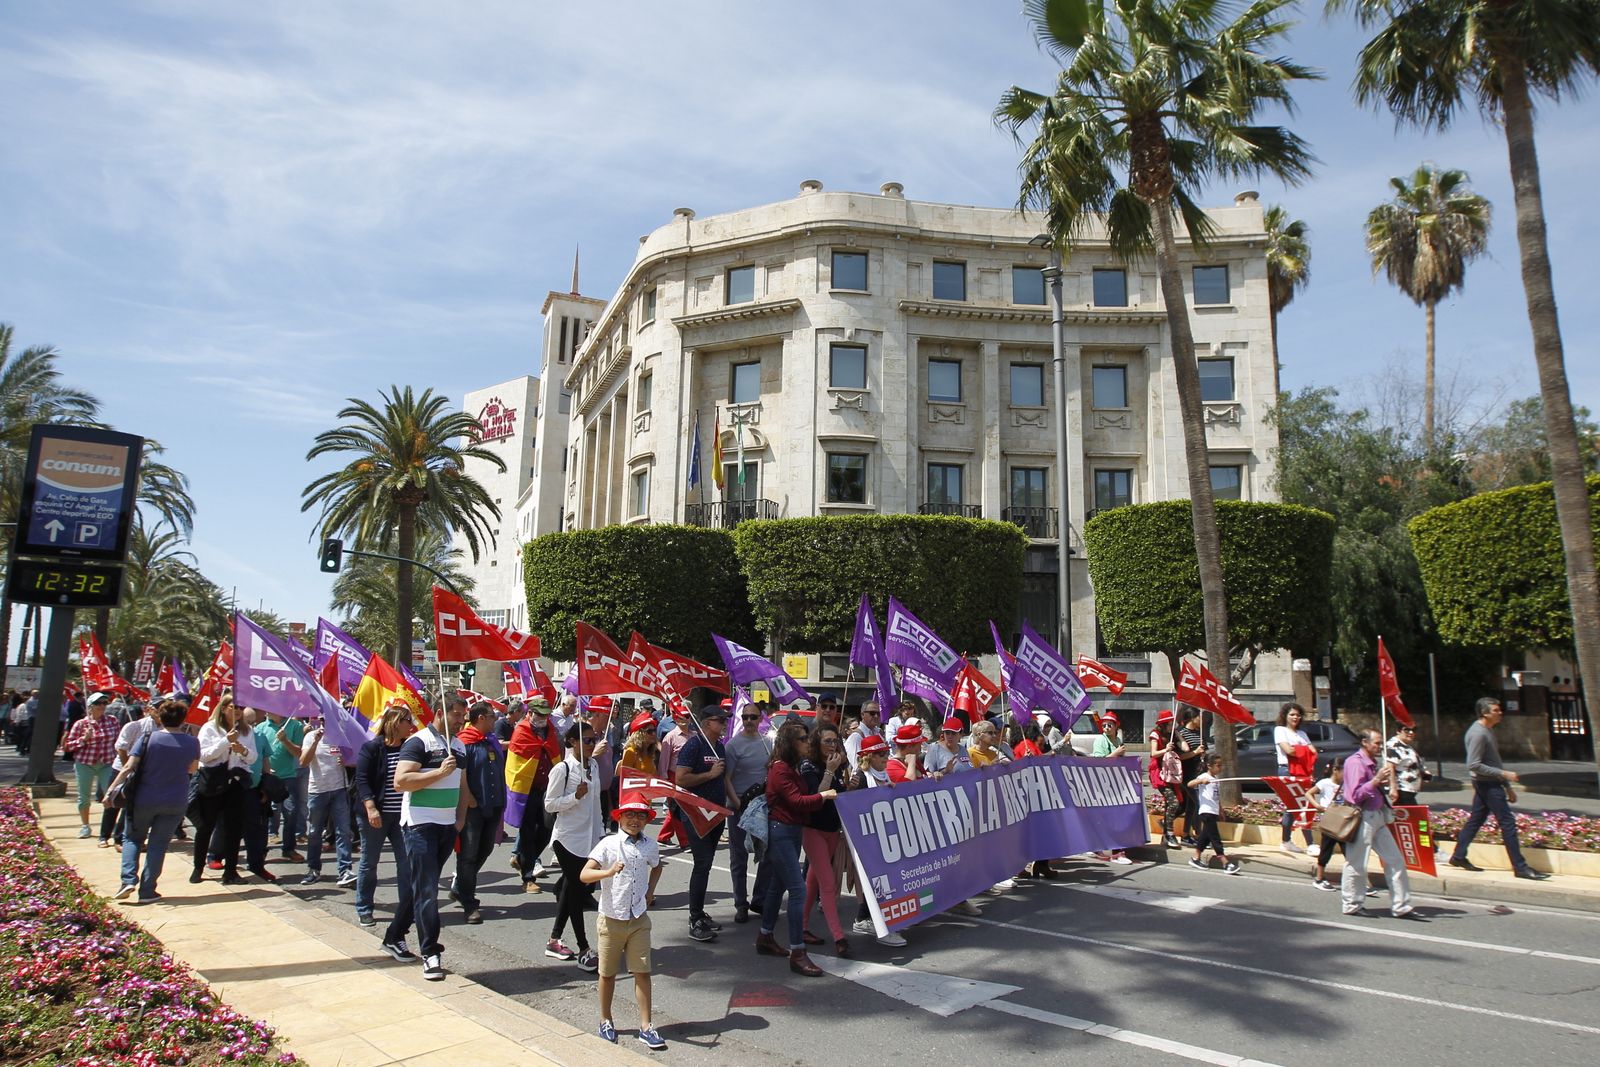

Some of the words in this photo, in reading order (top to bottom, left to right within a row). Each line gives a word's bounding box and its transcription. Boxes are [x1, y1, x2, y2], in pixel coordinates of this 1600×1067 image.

[42, 460, 120, 477] consum
[80, 524, 98, 542] P
[35, 573, 105, 593] 12:32
[896, 617, 941, 655] CCOO
[1022, 641, 1072, 689] CCOO
[859, 786, 975, 863] "CONTRA
[976, 778, 1001, 834] LA
[1061, 765, 1142, 807] SALARIAL"
[903, 879, 921, 892] CCOO
[881, 898, 917, 921] CCOO
